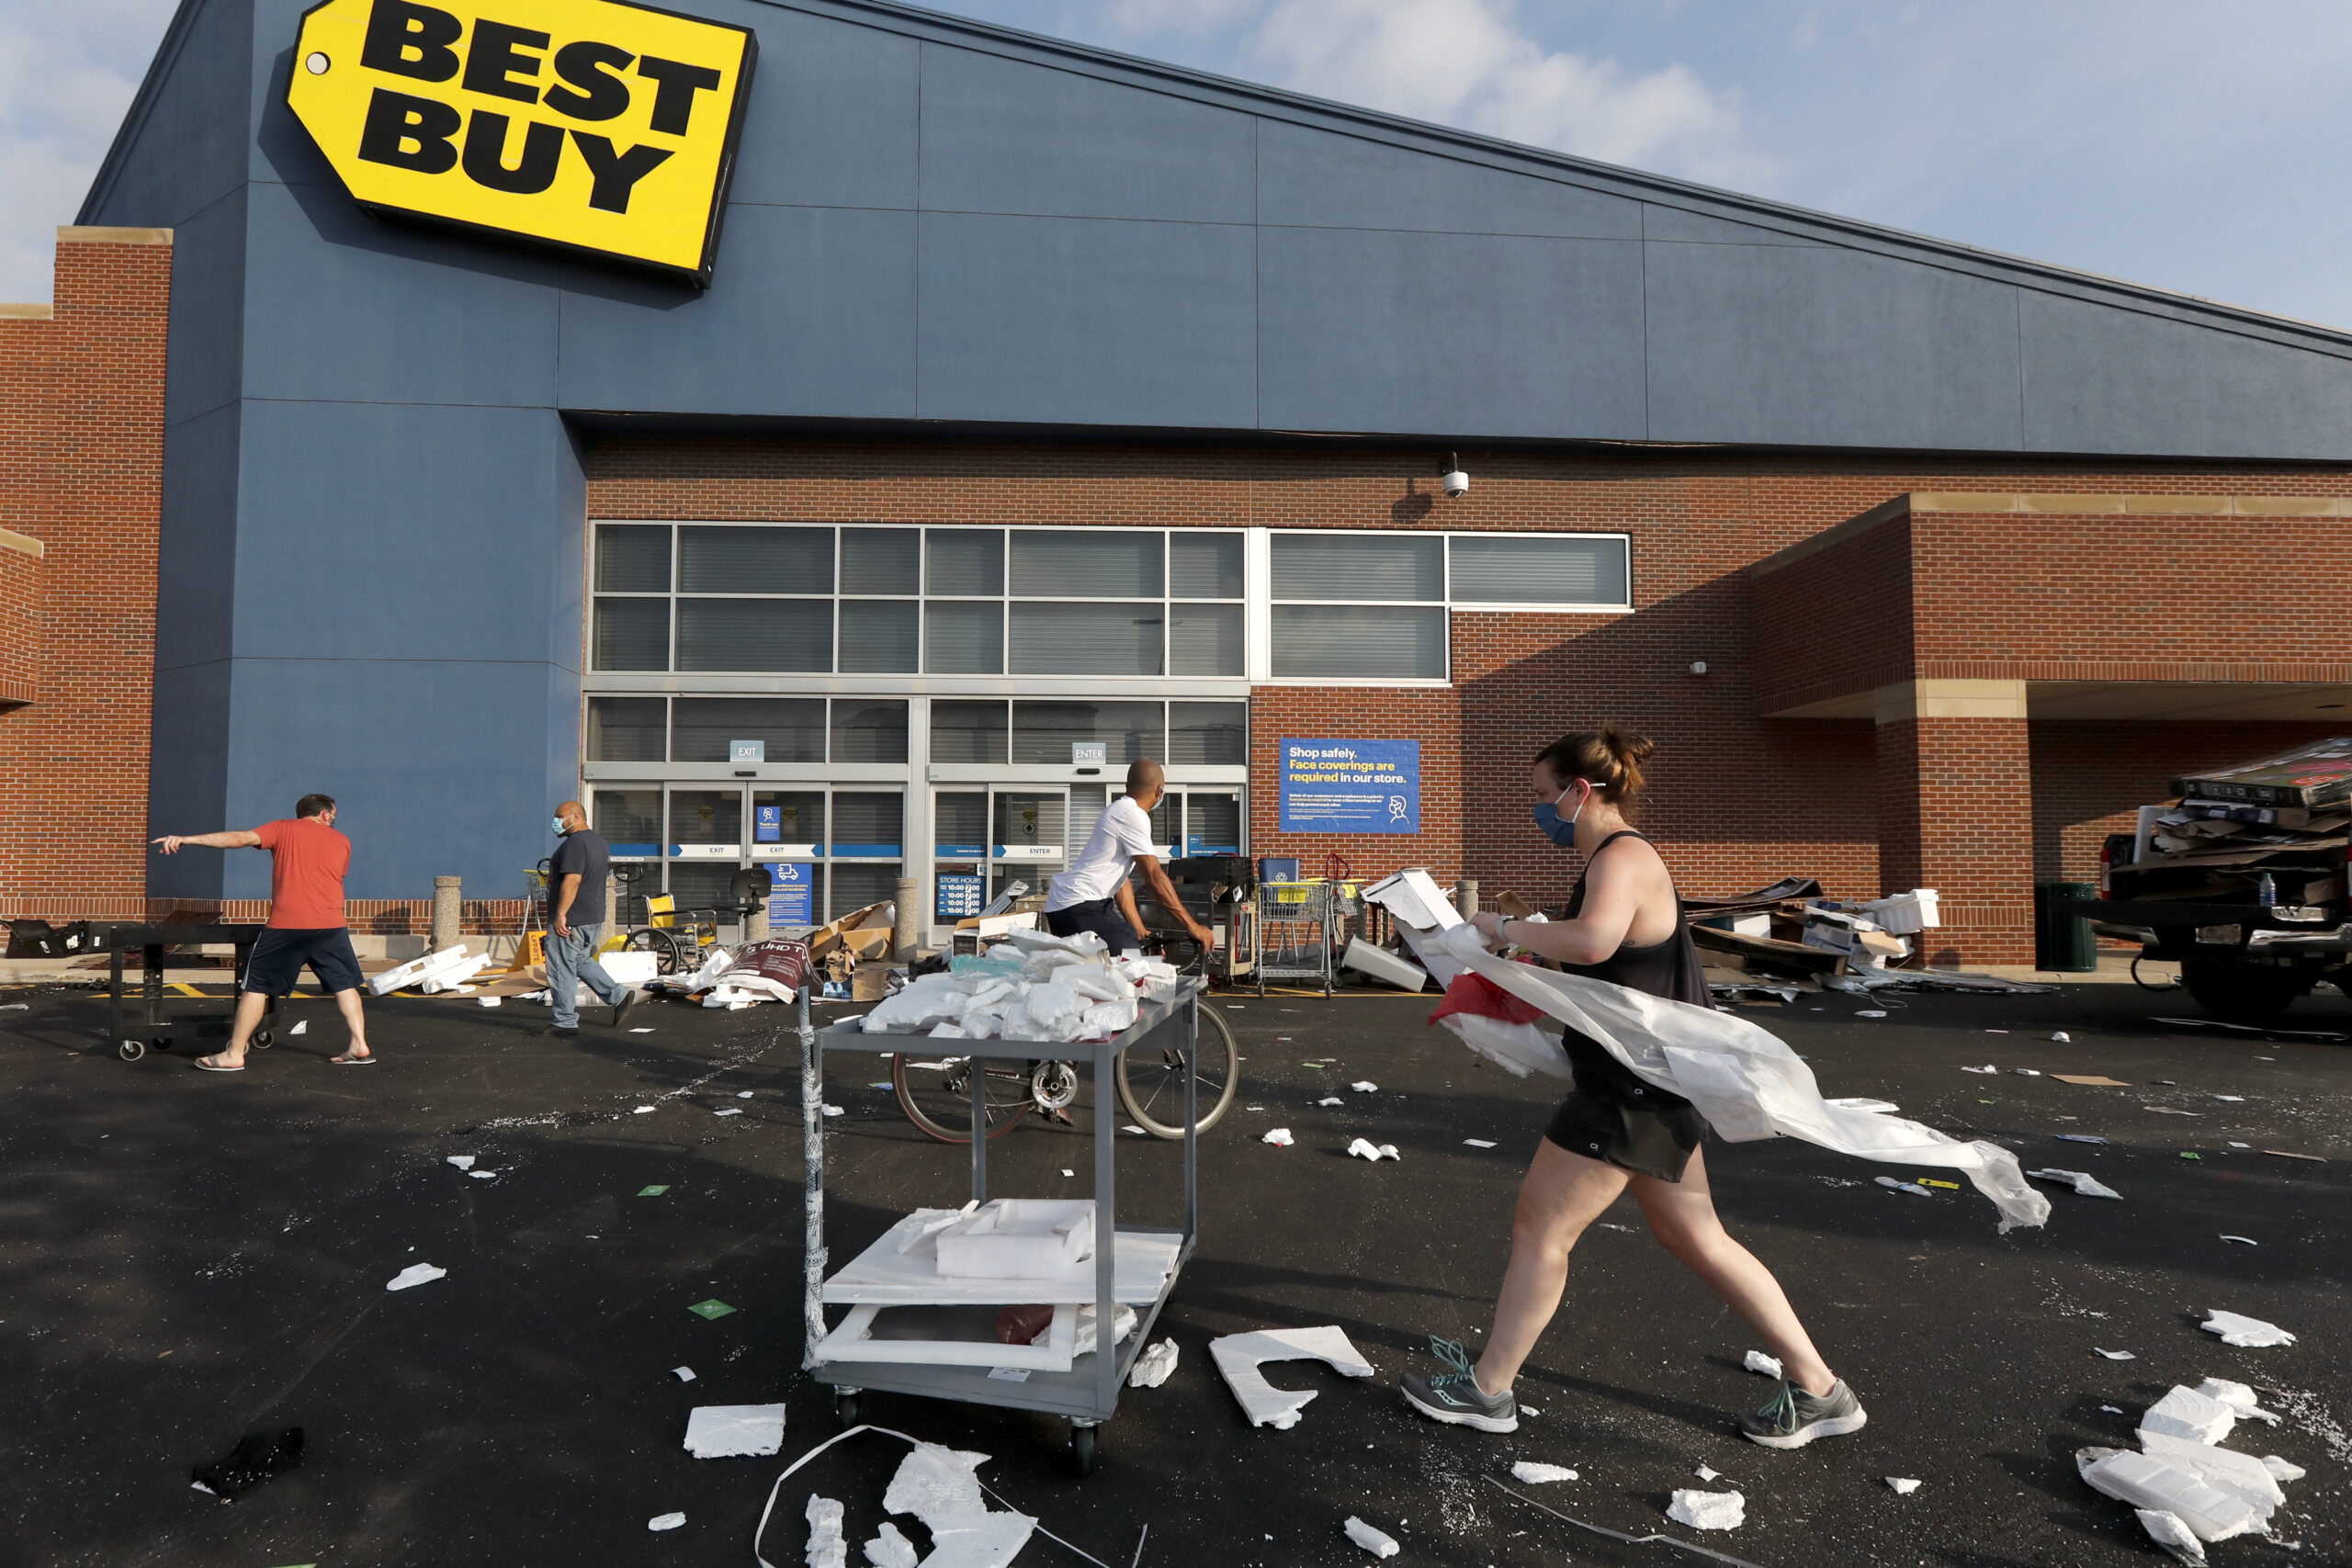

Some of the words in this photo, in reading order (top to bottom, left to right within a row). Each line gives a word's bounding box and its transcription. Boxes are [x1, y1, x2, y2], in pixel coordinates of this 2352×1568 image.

[360, 0, 721, 137] BEST
[357, 87, 676, 215] BUY
[738, 747, 757, 756] EXIT
[1075, 749, 1103, 759] ENTER
[1289, 747, 1319, 760] Shop
[1321, 748, 1358, 761] safely.
[1289, 760, 1317, 770] Face
[1318, 761, 1375, 773] coverings
[1376, 763, 1396, 772] are
[1289, 773, 1339, 784] required
[1340, 773, 1351, 783] in
[1352, 774, 1373, 784] our
[1374, 774, 1407, 784] store.
[760, 943, 791, 952] UHD
